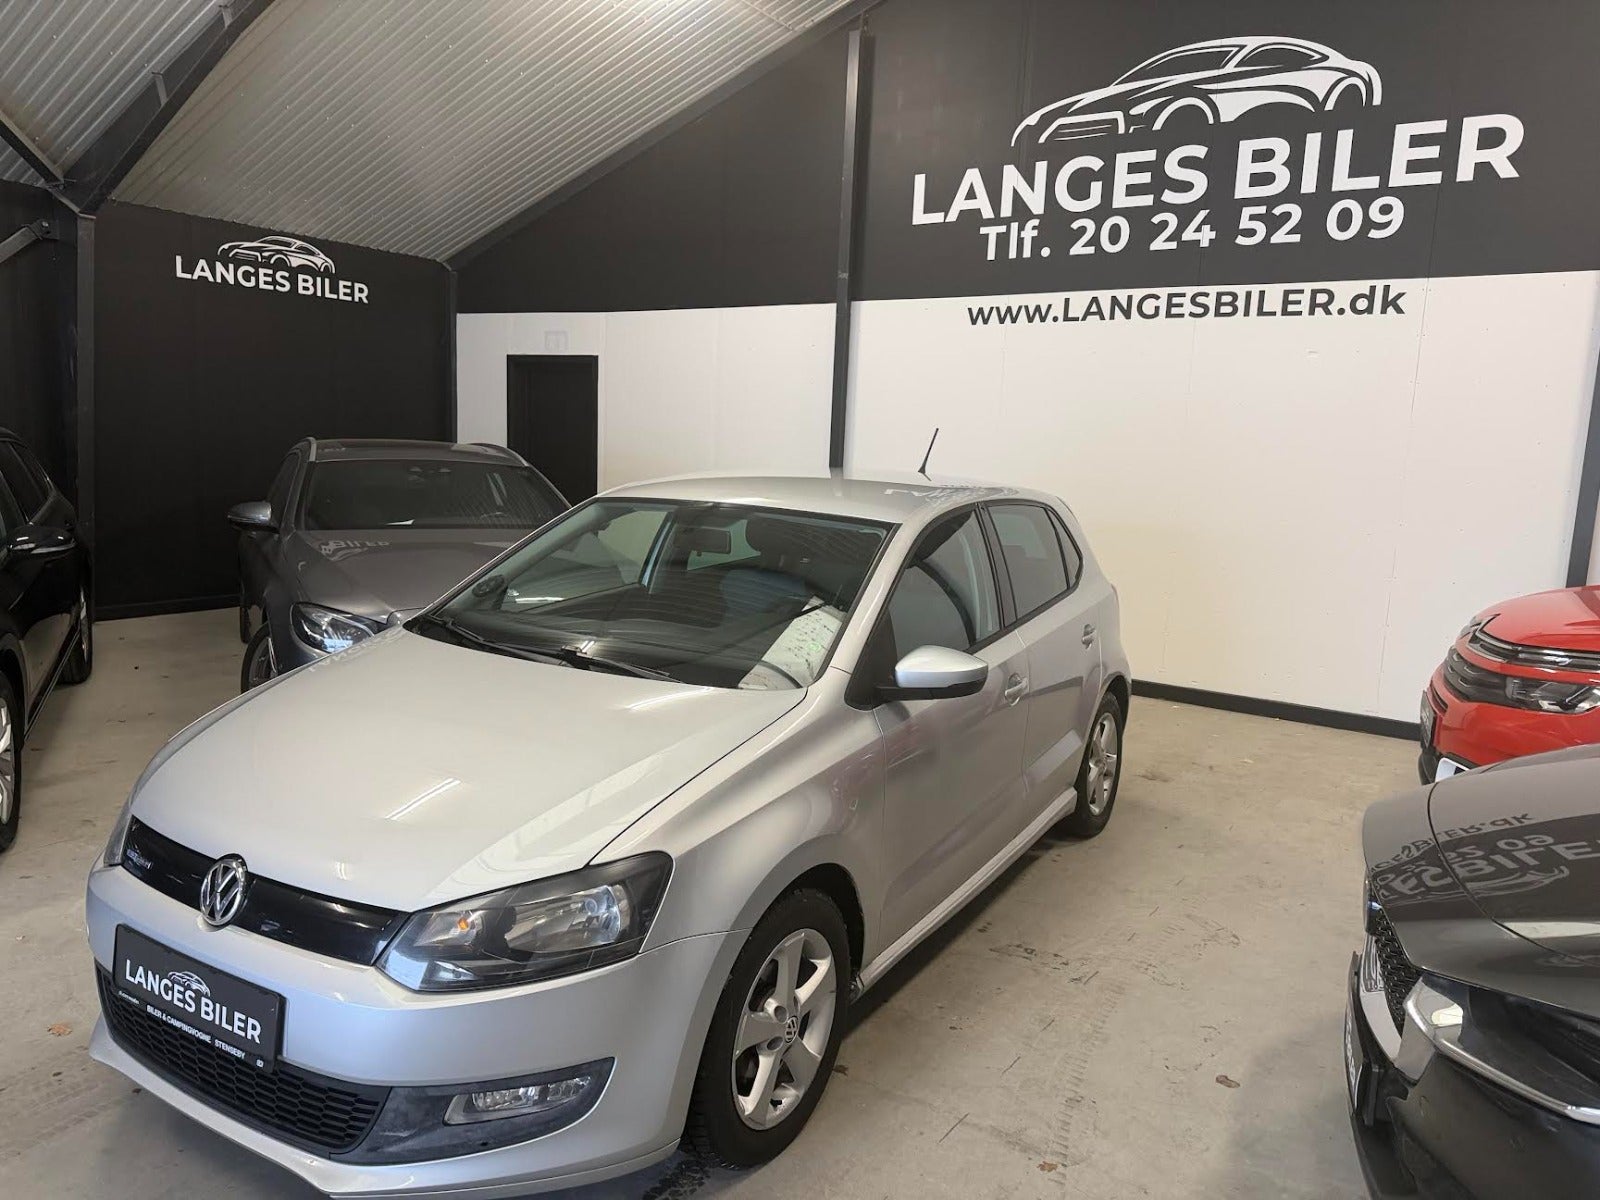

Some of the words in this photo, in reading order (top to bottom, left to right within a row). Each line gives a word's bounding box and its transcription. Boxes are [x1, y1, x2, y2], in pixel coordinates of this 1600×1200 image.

[911, 144, 1209, 226] LANGES
[1233, 113, 1525, 200] BILER
[979, 219, 1051, 261] Tlf.
[1069, 215, 1130, 256] 20
[1149, 209, 1217, 251] 24
[1234, 203, 1303, 246] 52
[1326, 195, 1405, 241] 09
[175, 255, 291, 293] LANGES
[297, 273, 369, 304] BILER
[967, 284, 1407, 326] www.LANGESBILER.dk
[125, 958, 196, 1013] LANGES
[200, 996, 262, 1044] BILER
